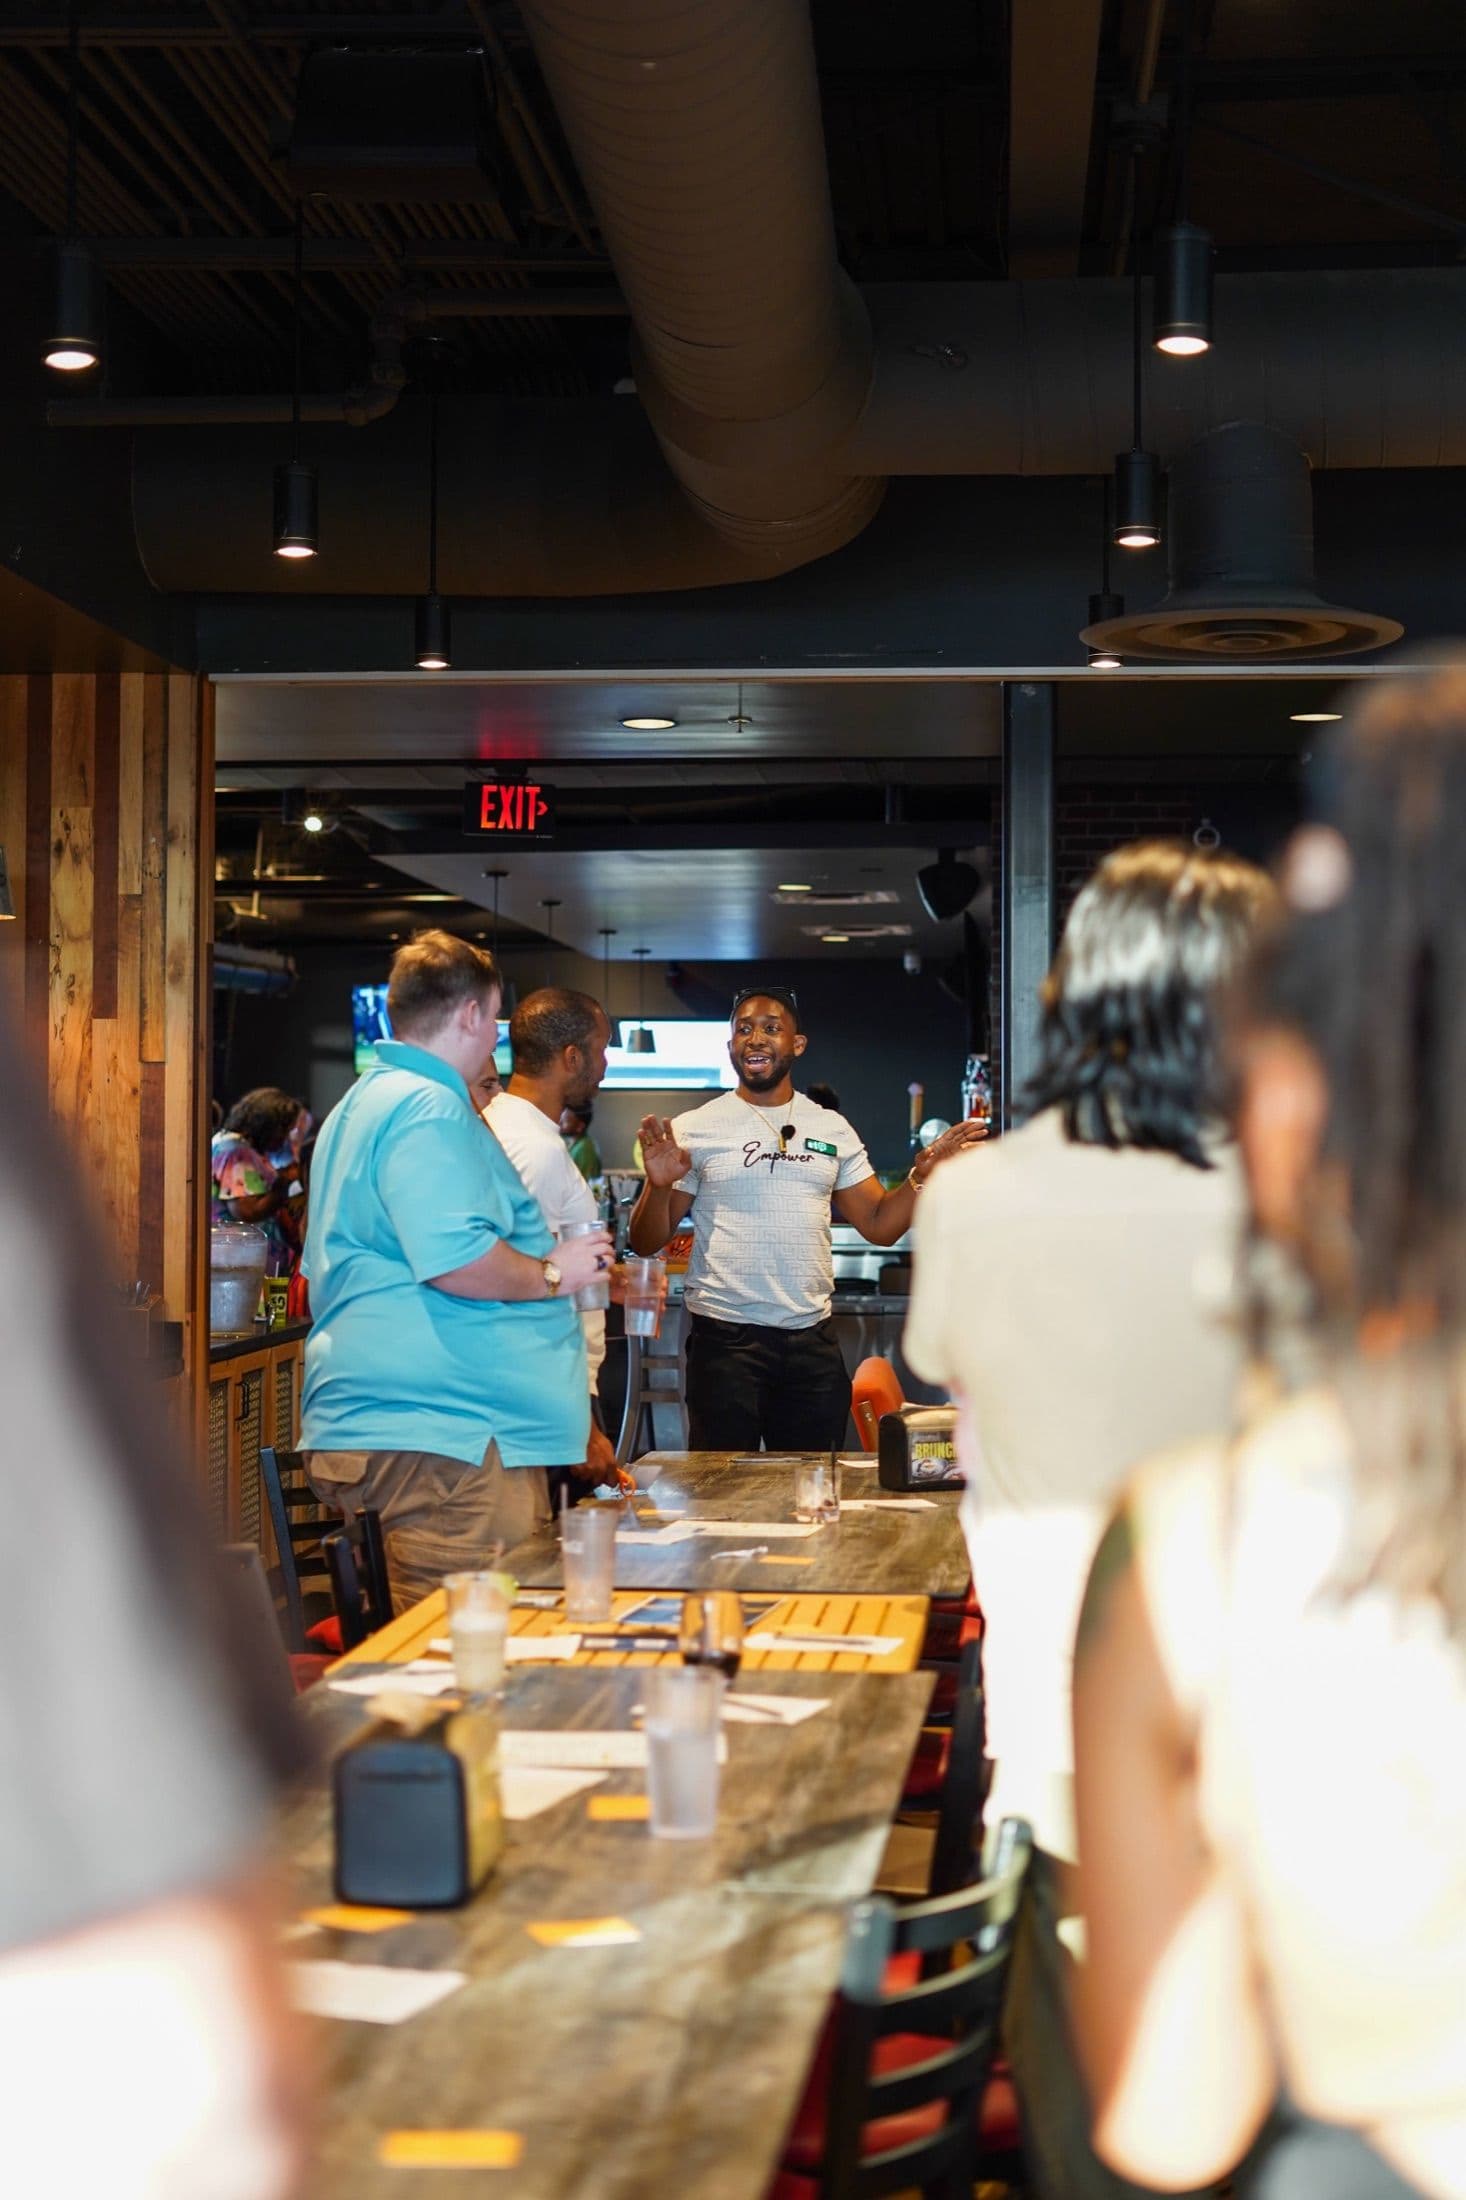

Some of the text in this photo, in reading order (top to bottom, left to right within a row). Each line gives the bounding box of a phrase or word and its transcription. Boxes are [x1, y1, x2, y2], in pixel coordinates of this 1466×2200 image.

[480, 784, 541, 830] EXIT
[742, 1141, 815, 1174] Empower
[914, 1442, 957, 1459] BRUNC
